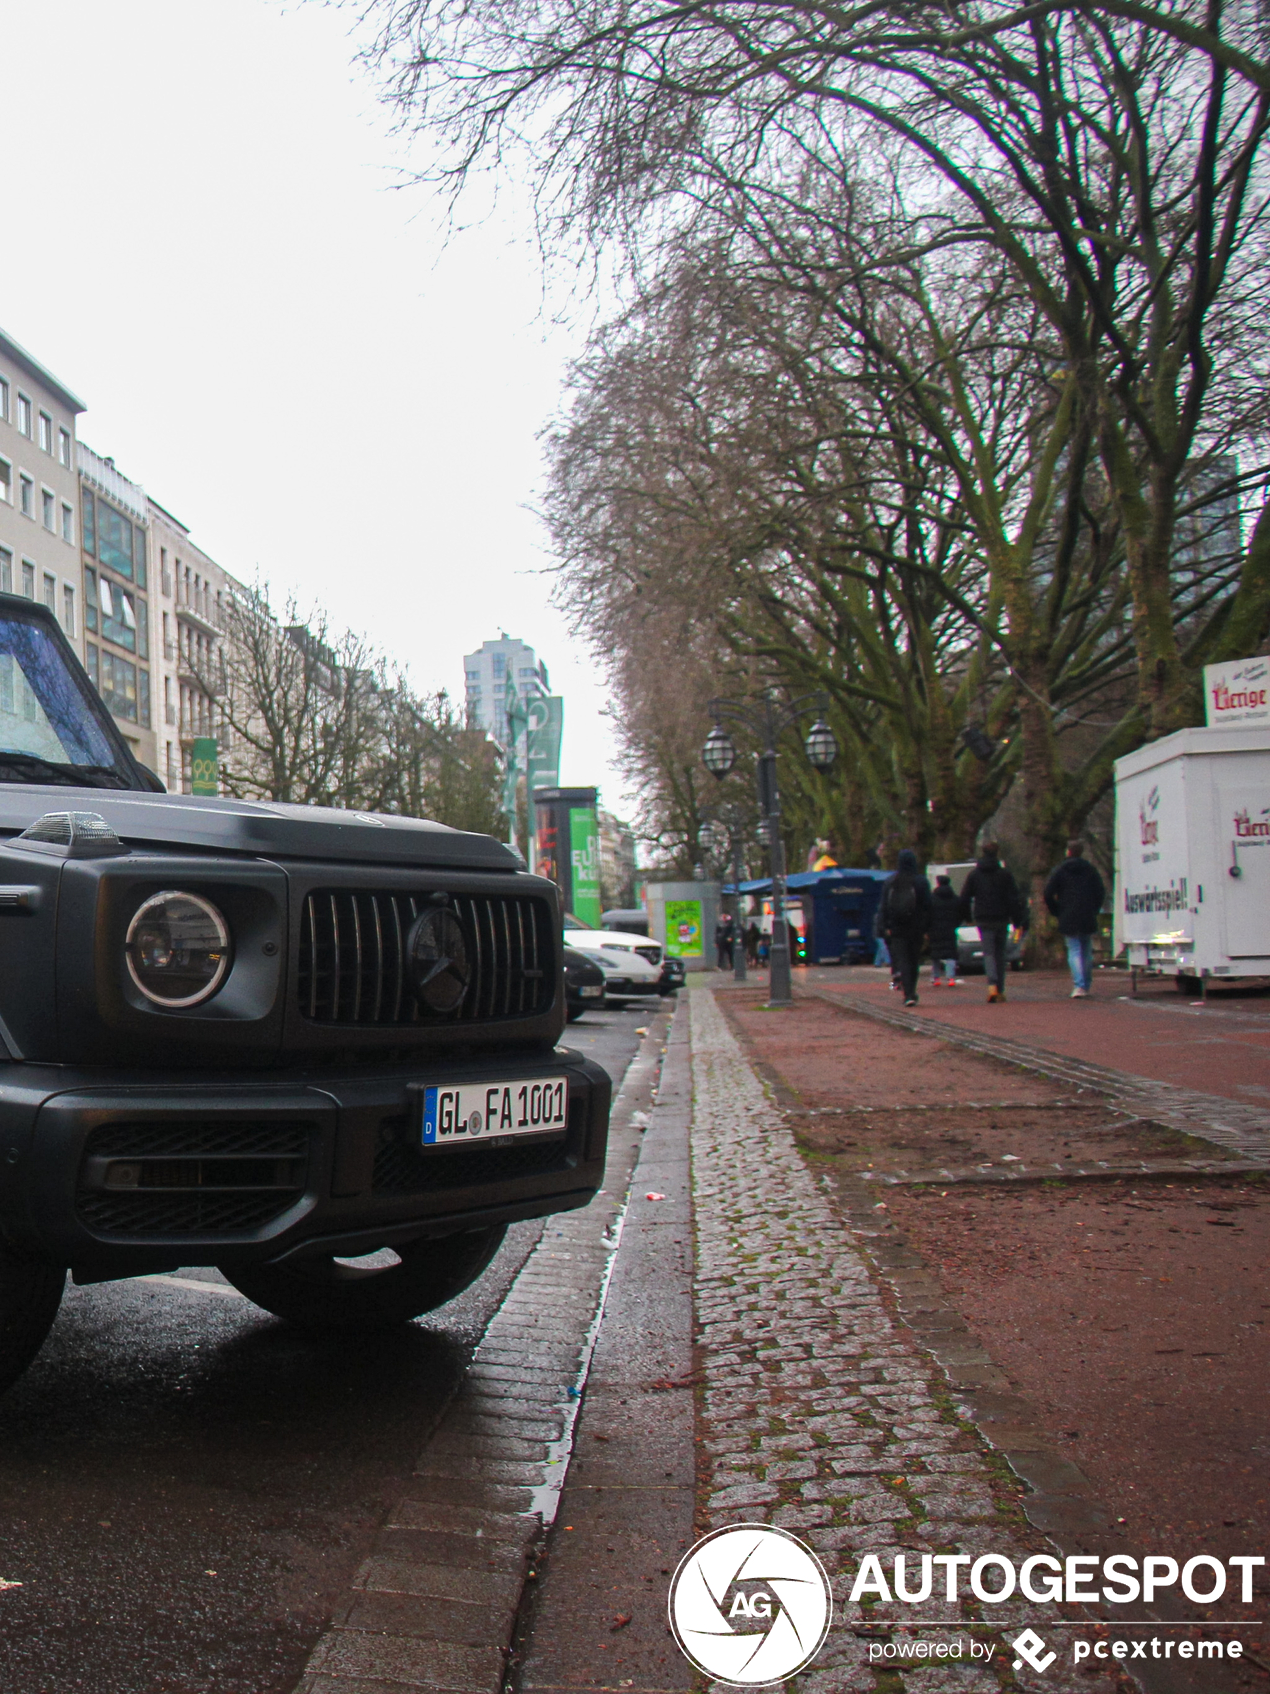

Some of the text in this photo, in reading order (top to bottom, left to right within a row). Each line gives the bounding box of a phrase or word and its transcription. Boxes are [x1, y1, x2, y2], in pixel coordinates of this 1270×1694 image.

[438, 1082, 564, 1135] GL FA 1001
